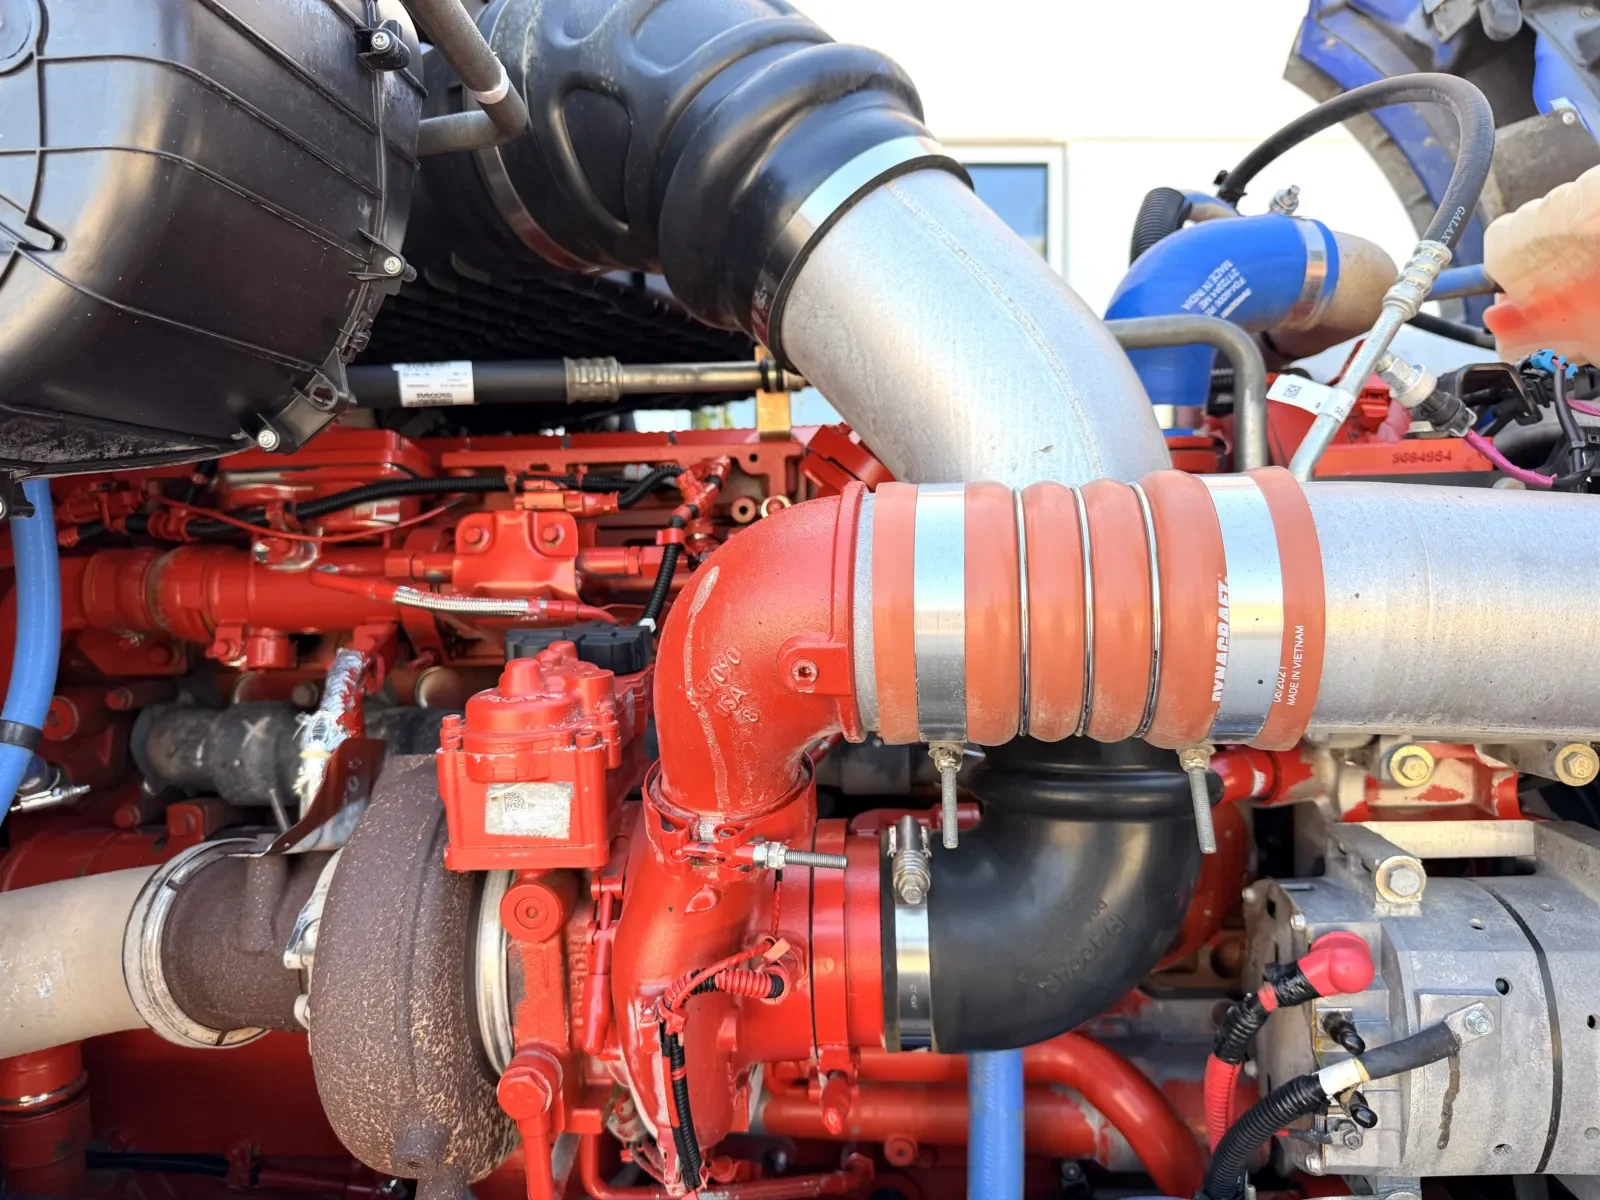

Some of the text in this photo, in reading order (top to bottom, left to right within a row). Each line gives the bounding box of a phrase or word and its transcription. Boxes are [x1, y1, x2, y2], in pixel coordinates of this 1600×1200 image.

[1201, 280, 1214, 292] IN
[1286, 625, 1305, 706] MADE IN VIETNAM
[713, 684, 749, 718] USA
